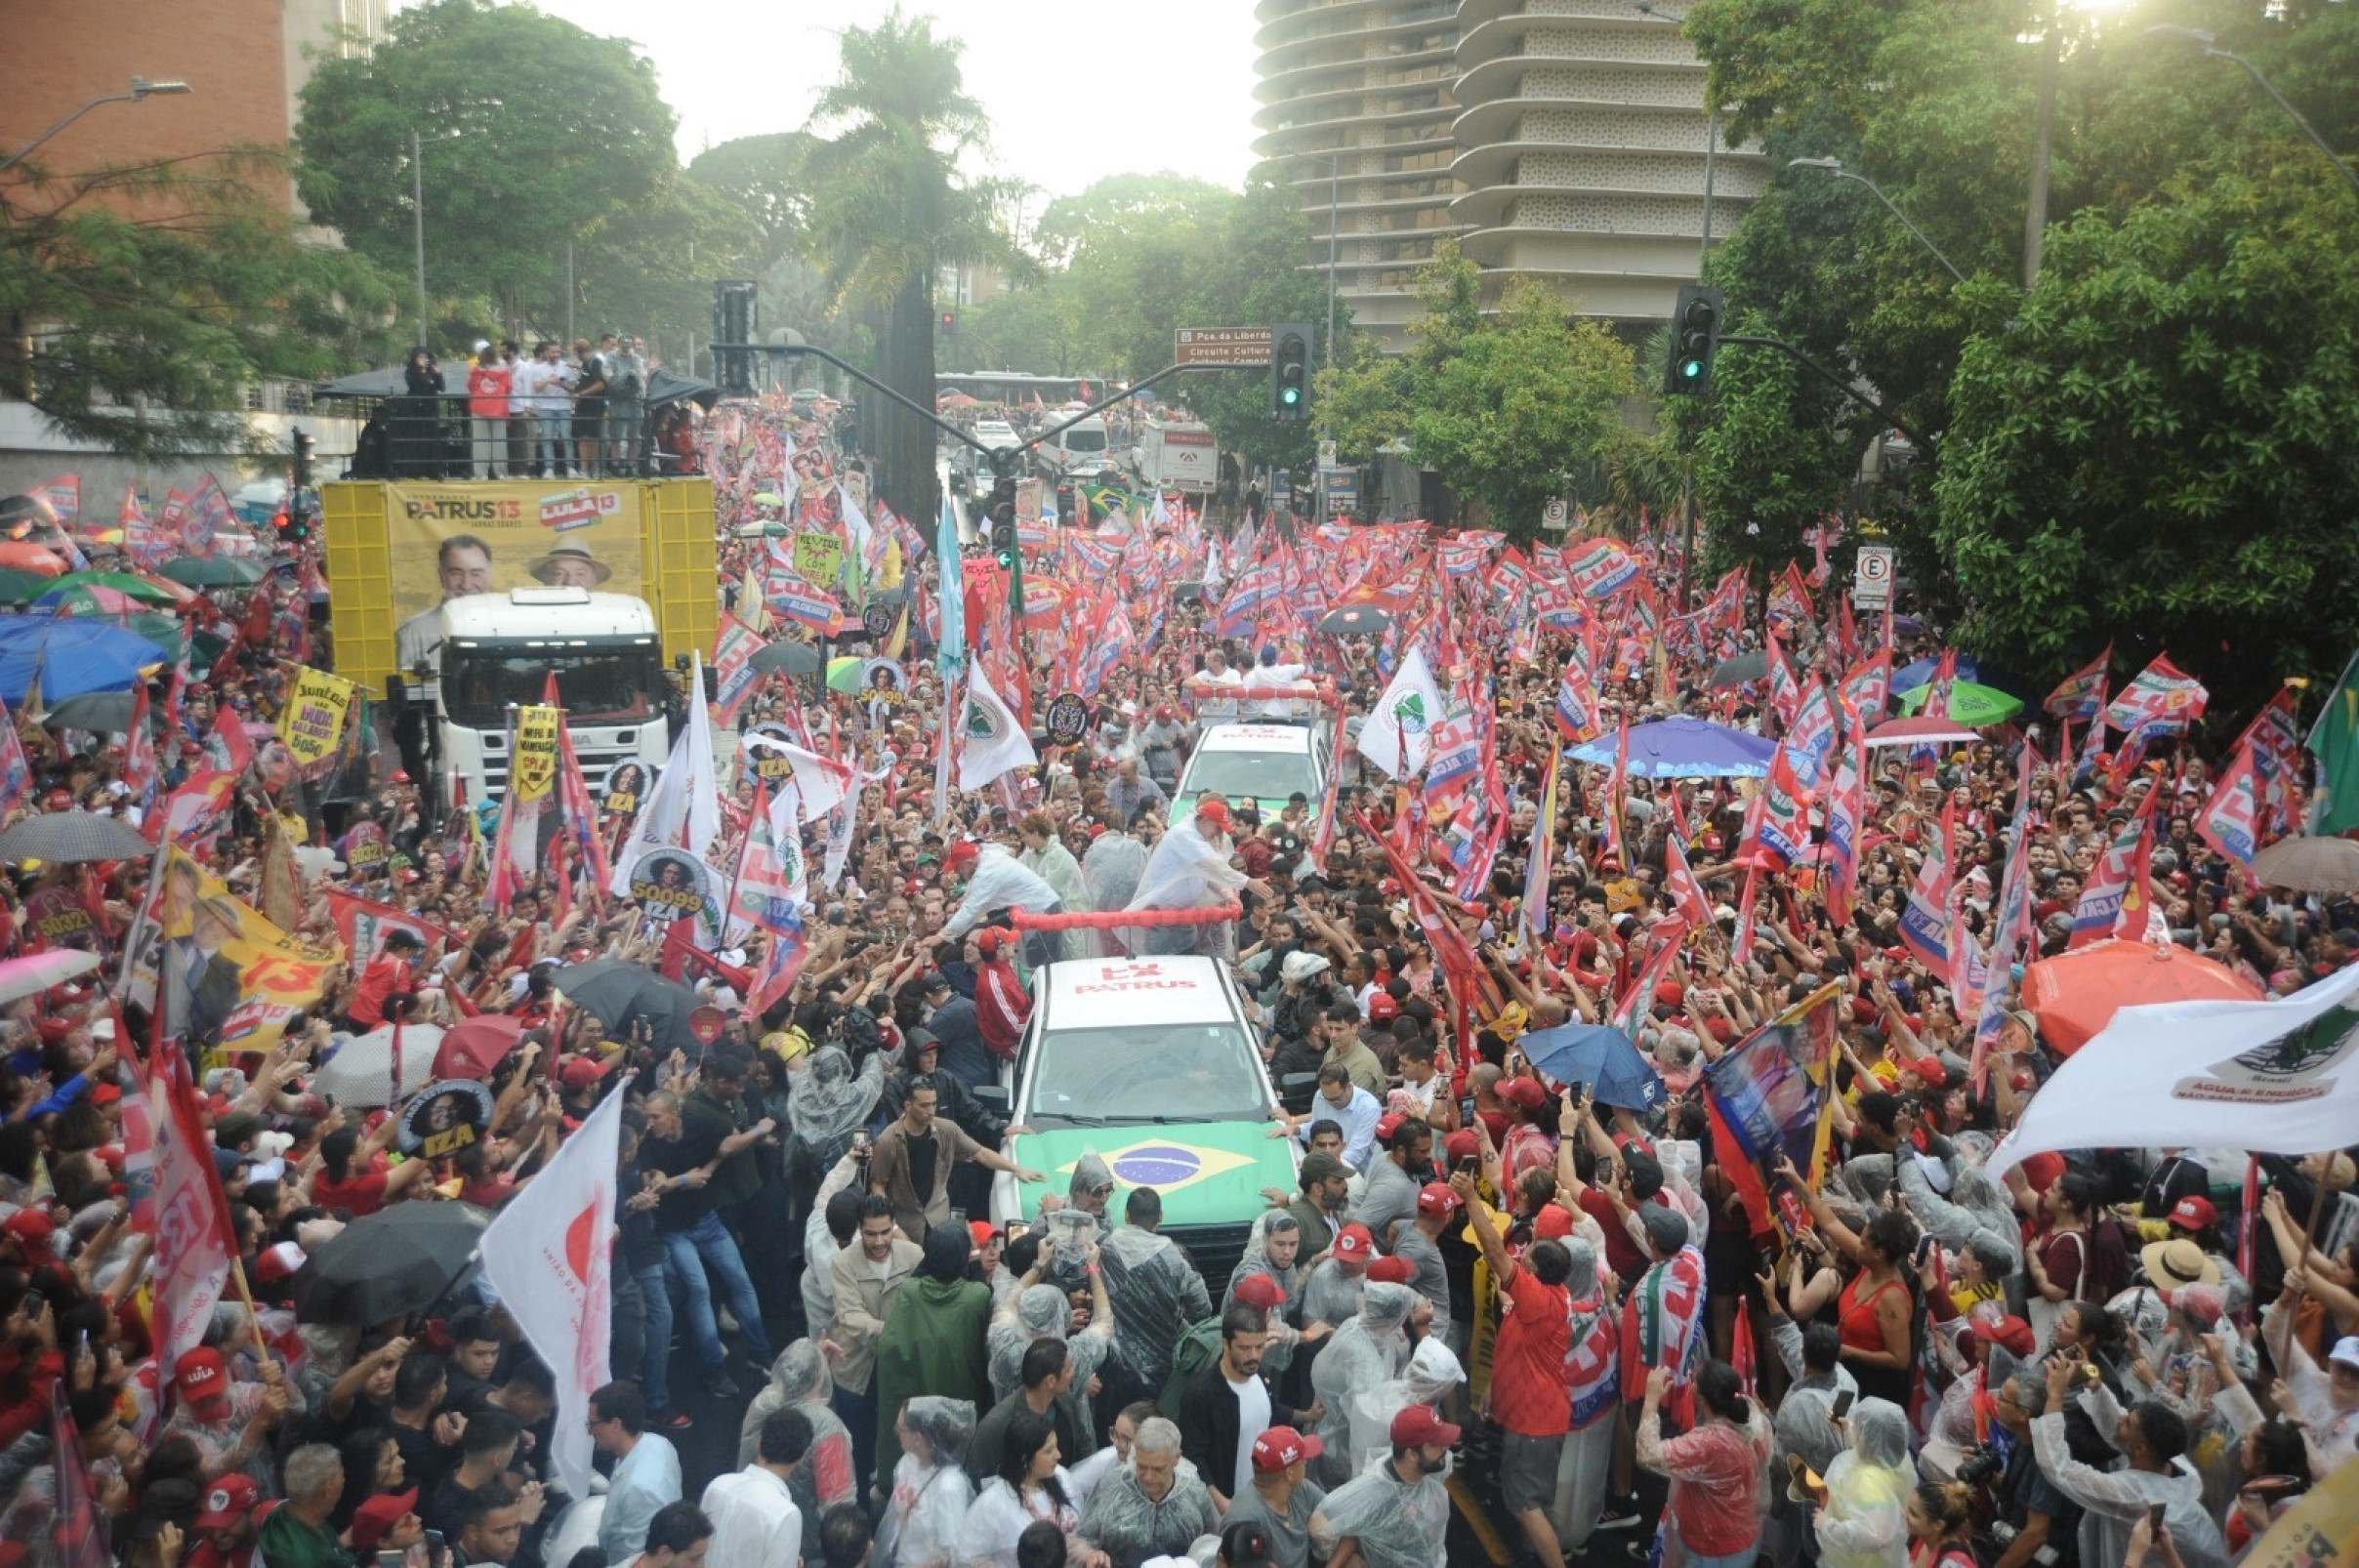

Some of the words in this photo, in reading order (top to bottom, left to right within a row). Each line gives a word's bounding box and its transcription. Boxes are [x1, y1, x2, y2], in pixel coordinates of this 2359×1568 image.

[1234, 330, 1271, 340] Liberda
[1190, 347, 1229, 357] Circuito
[1234, 347, 1271, 355] Cultura
[542, 499, 598, 518] LULA
[1551, 505, 1558, 516] E
[1870, 560, 1880, 575] E
[633, 881, 702, 912] 50099
[1075, 980, 1197, 994] PATRUS
[424, 1122, 476, 1158] IZA
[188, 1368, 214, 1382] LULA
